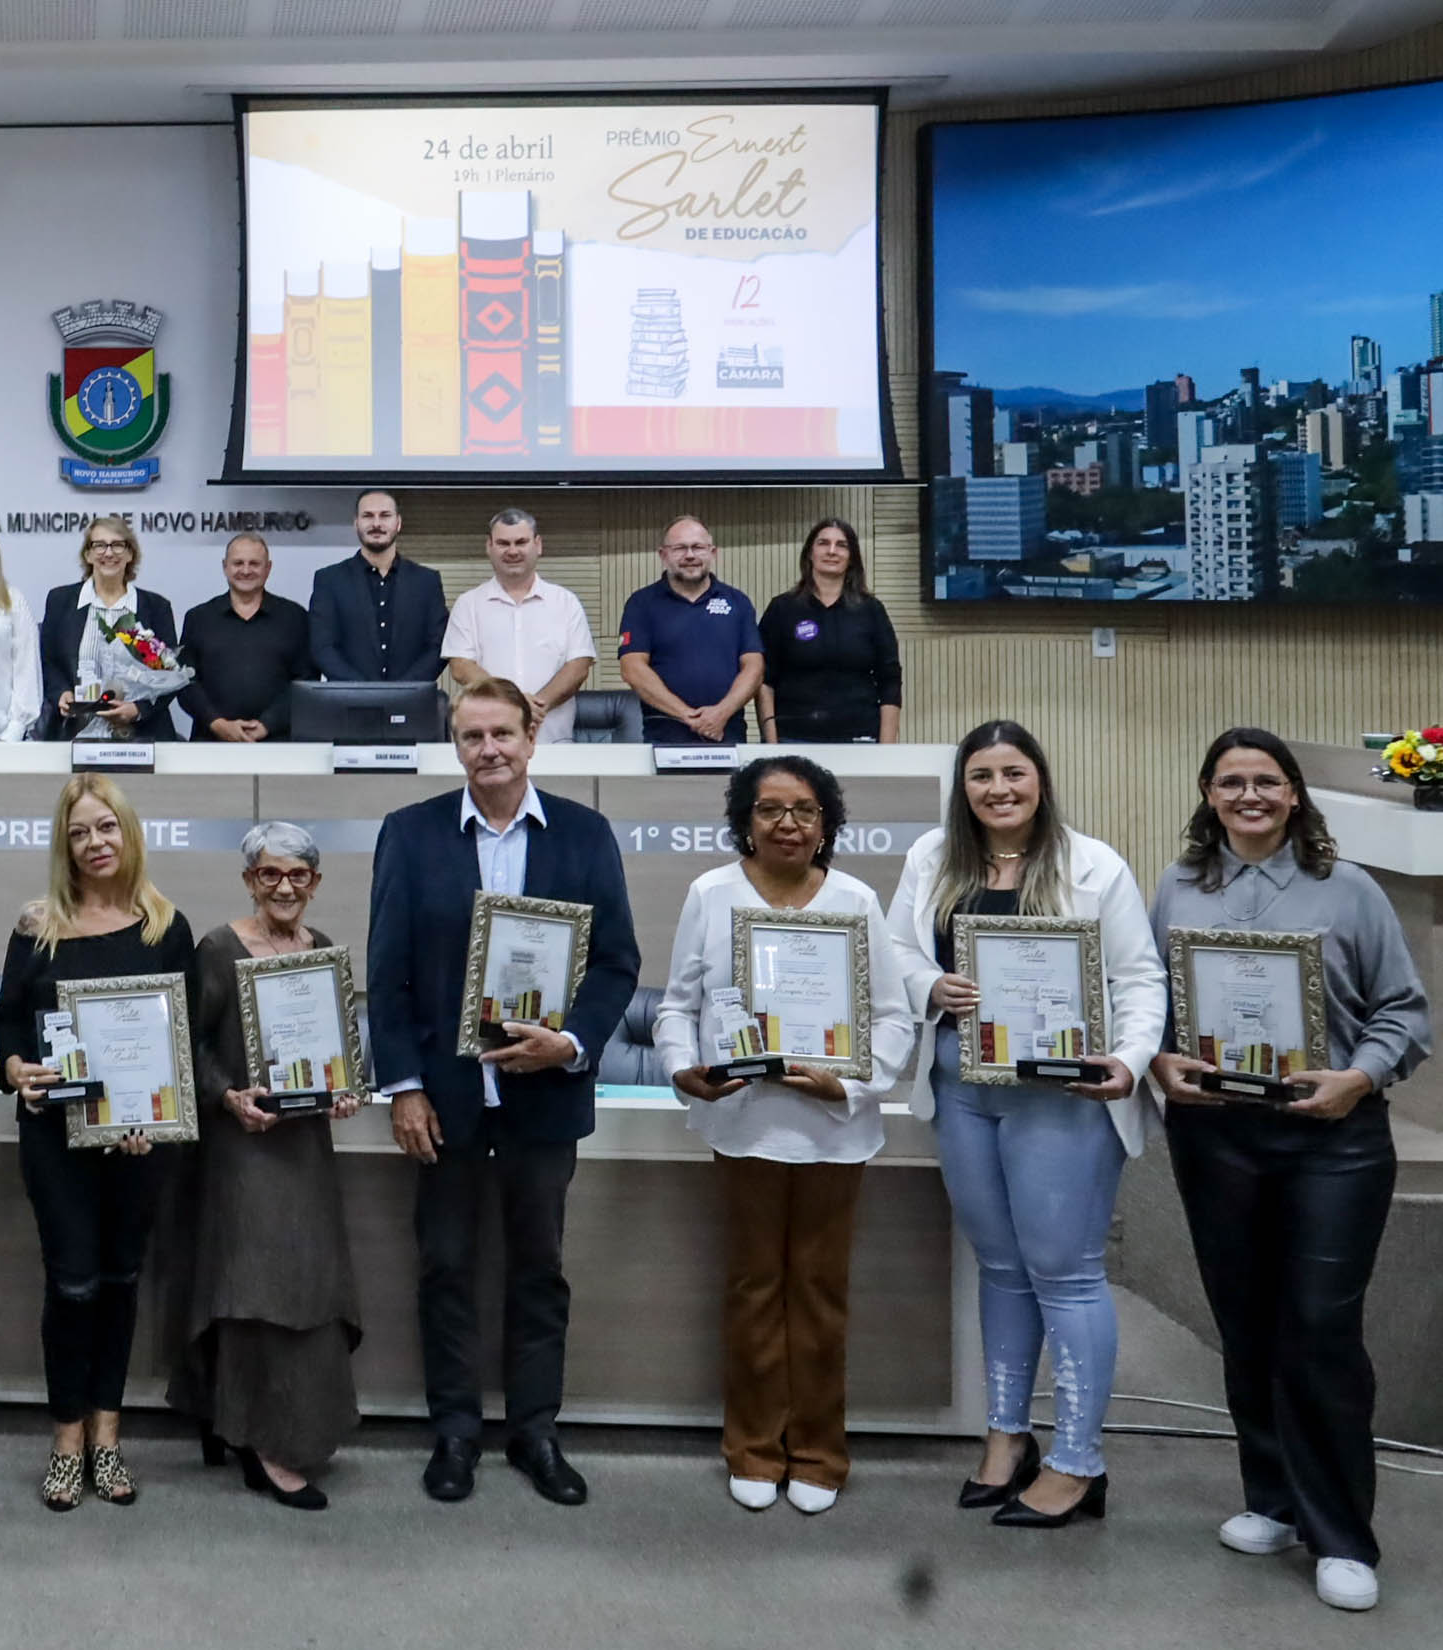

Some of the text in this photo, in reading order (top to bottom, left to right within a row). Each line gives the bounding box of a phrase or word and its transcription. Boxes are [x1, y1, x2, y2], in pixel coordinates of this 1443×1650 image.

[422, 134, 554, 160] 24 de abril
[606, 114, 808, 164] PRÊMIO Ernest
[453, 167, 555, 183] 19h Plenário
[607, 150, 807, 241] Sarlet
[685, 227, 712, 241] DE
[731, 274, 761, 311] 12
[140, 511, 196, 533] NOVO
